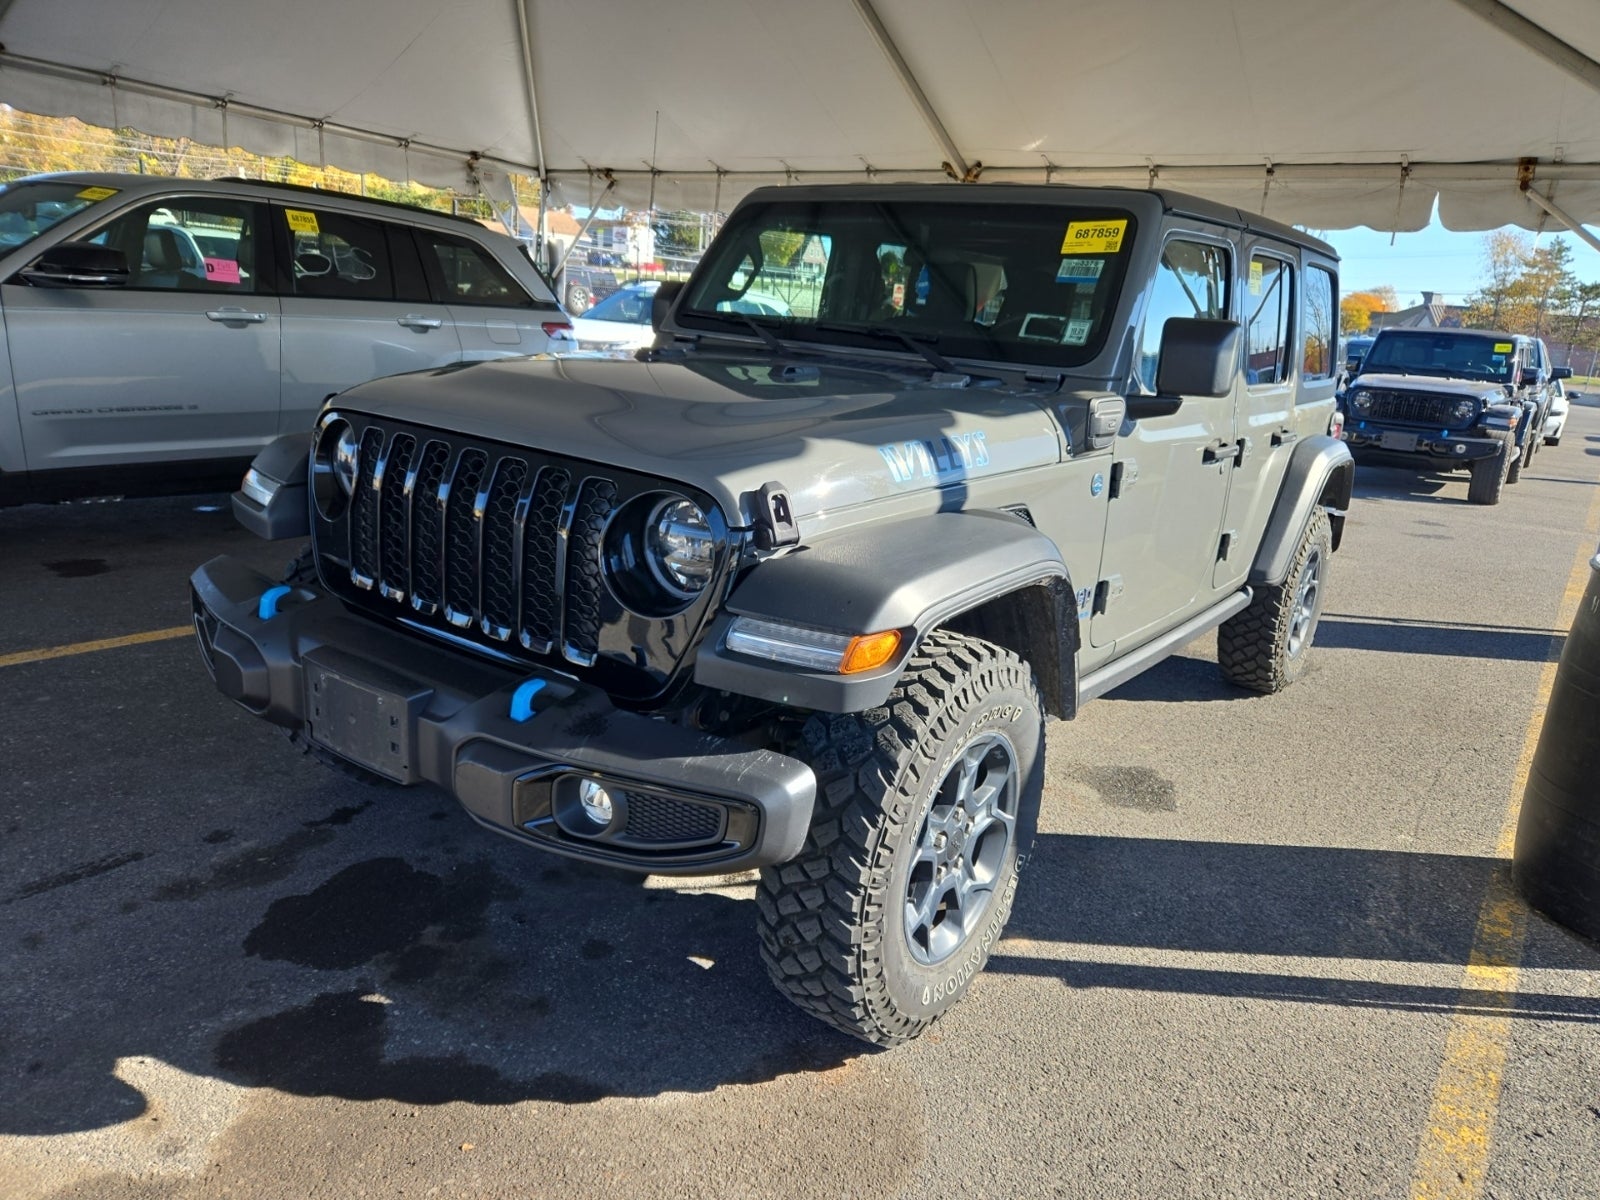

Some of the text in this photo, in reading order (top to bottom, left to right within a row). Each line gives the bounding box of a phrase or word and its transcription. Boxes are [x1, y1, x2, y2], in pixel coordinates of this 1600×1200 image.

[1075, 227, 1120, 239] 687859
[206, 263, 215, 273] D
[878, 431, 990, 483] WILLYS
[934, 854, 1026, 1003] DESTINATION
